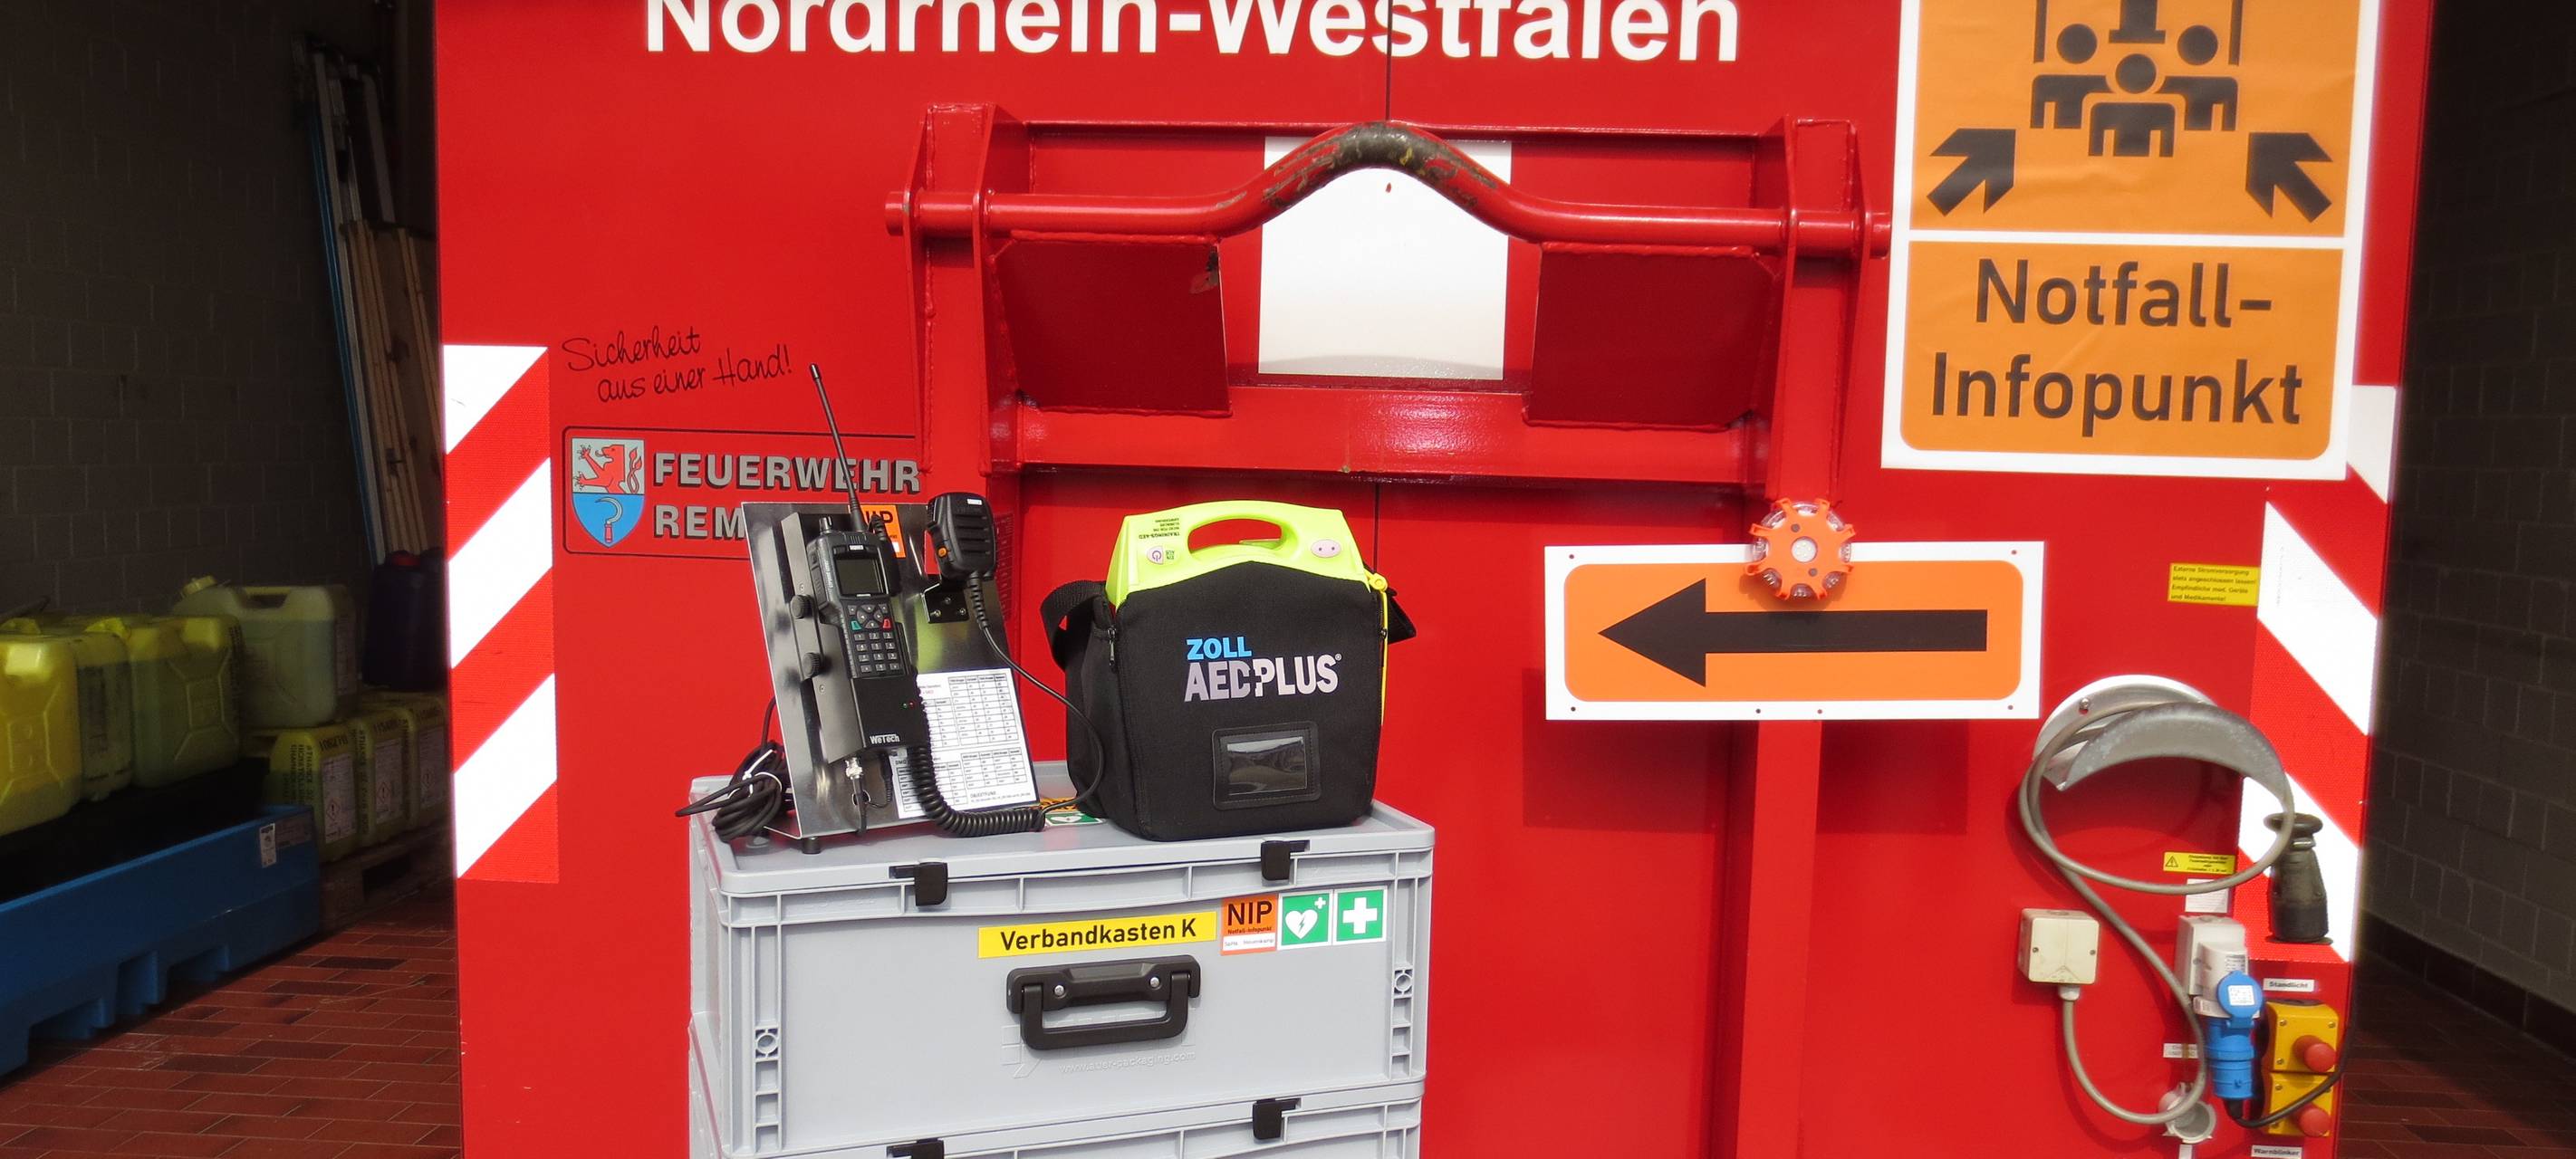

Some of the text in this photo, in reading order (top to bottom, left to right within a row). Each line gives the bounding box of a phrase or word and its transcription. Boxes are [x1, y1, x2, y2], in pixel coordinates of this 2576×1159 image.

[646, 0, 1740, 62] Nordrhein-Westfalen
[1975, 258, 2273, 329] Notfall-
[562, 325, 701, 372] Sicherheit
[598, 344, 793, 403] aus einer Hand!
[1931, 350, 2303, 438] Infopunkt
[653, 451, 922, 494] FEUERWEHR
[1186, 636, 1252, 661] ZOLL
[1001, 918, 1197, 952] Verbandkasten K
[1227, 900, 1273, 926] NIP
